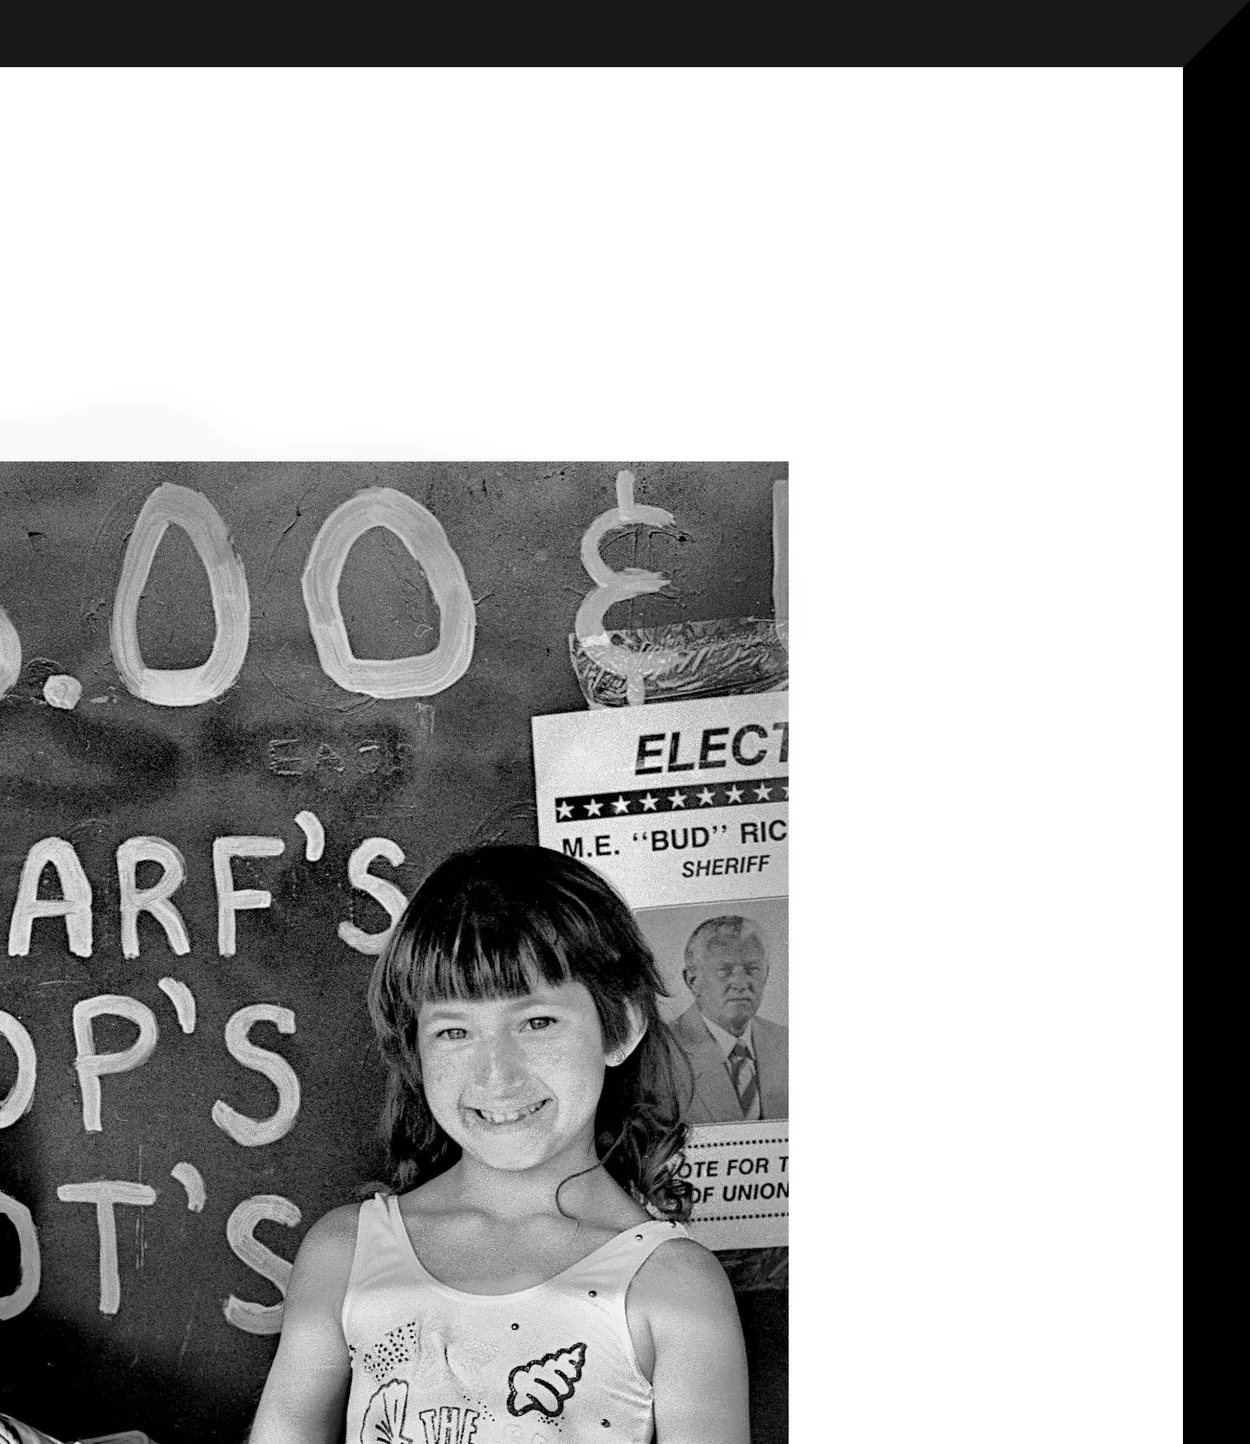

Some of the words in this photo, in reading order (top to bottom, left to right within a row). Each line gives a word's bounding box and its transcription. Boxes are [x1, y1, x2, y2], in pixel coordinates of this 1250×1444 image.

[635, 721, 789, 775] ELECT
[562, 834, 620, 858] M.E.
[682, 854, 771, 878] SHERIFF
[677, 1160, 719, 1178] OTE
[726, 1157, 769, 1176] FOR
[722, 1181, 789, 1202] UNION
